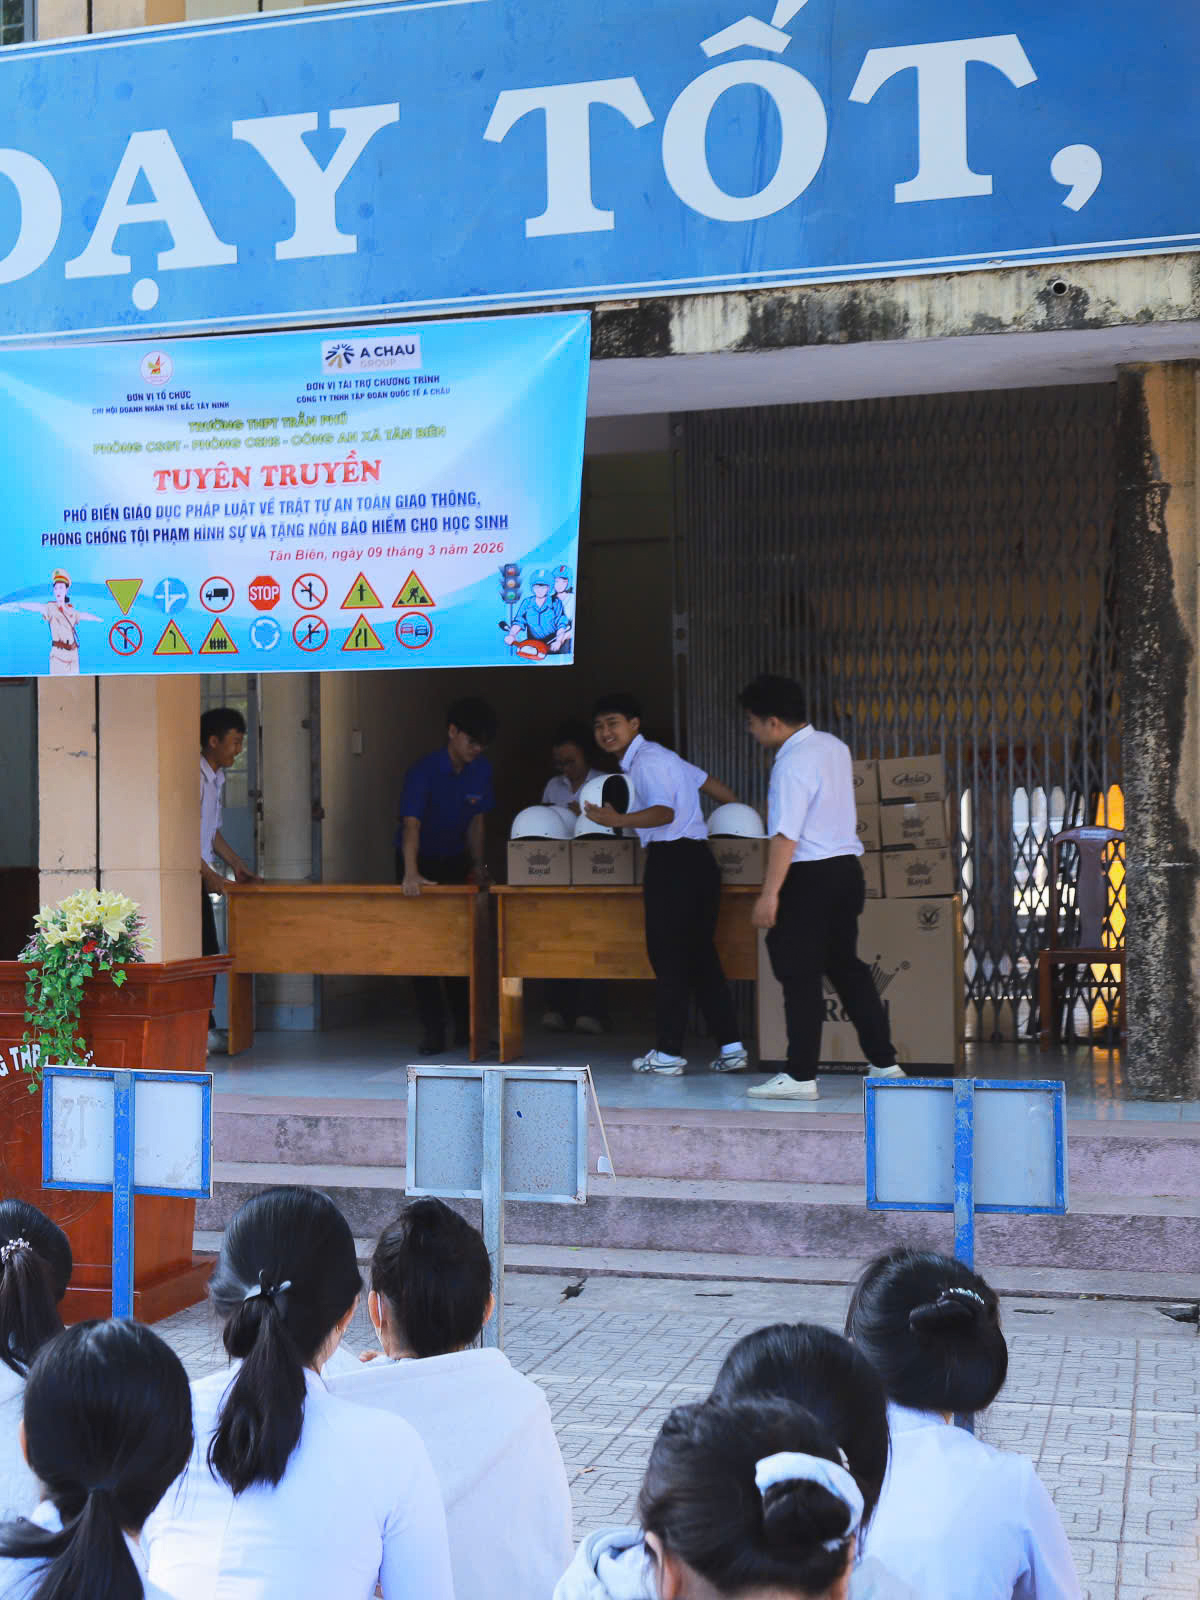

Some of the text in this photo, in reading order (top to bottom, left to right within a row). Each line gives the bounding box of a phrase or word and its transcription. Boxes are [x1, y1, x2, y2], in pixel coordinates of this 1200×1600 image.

[483, 0, 1103, 238] TỐT,
[360, 343, 415, 358] A CHAU
[360, 359, 397, 369] GROUP
[306, 375, 440, 391] ĐƠN VỊ TÀI TRỢ CHƯƠNG TRÌNH
[127, 392, 143, 402] ĐƠN
[146, 392, 154, 402] VỊ
[296, 394, 317, 404] CÔNG
[120, 405, 143, 414] DOANH
[188, 418, 244, 432] TRƯỜNG
[247, 417, 278, 430] THPT
[290, 432, 334, 446] CÔNG
[337, 431, 359, 444] AN
[153, 450, 382, 491] TUYÊN TRUYỀN
[63, 489, 481, 523] PHỔ BIẾN GIÁO DỤC PHÁP LUẬT VỀ TRẬT TỰ AN TOÀN GIAO THÔNG,
[41, 513, 509, 547] PHÒNG CHỐNG TỘI PHẠM HÌNH SỰ VÀ TẶNG NÓN BẢO HIỂM CHO HỌC SINH
[268, 542, 505, 562] Tân Biên, ngày 09 tháng 3 năm 2026
[250, 585, 280, 600] STOP
[907, 876, 931, 887] Royal
[9, 1044, 48, 1071] THP
